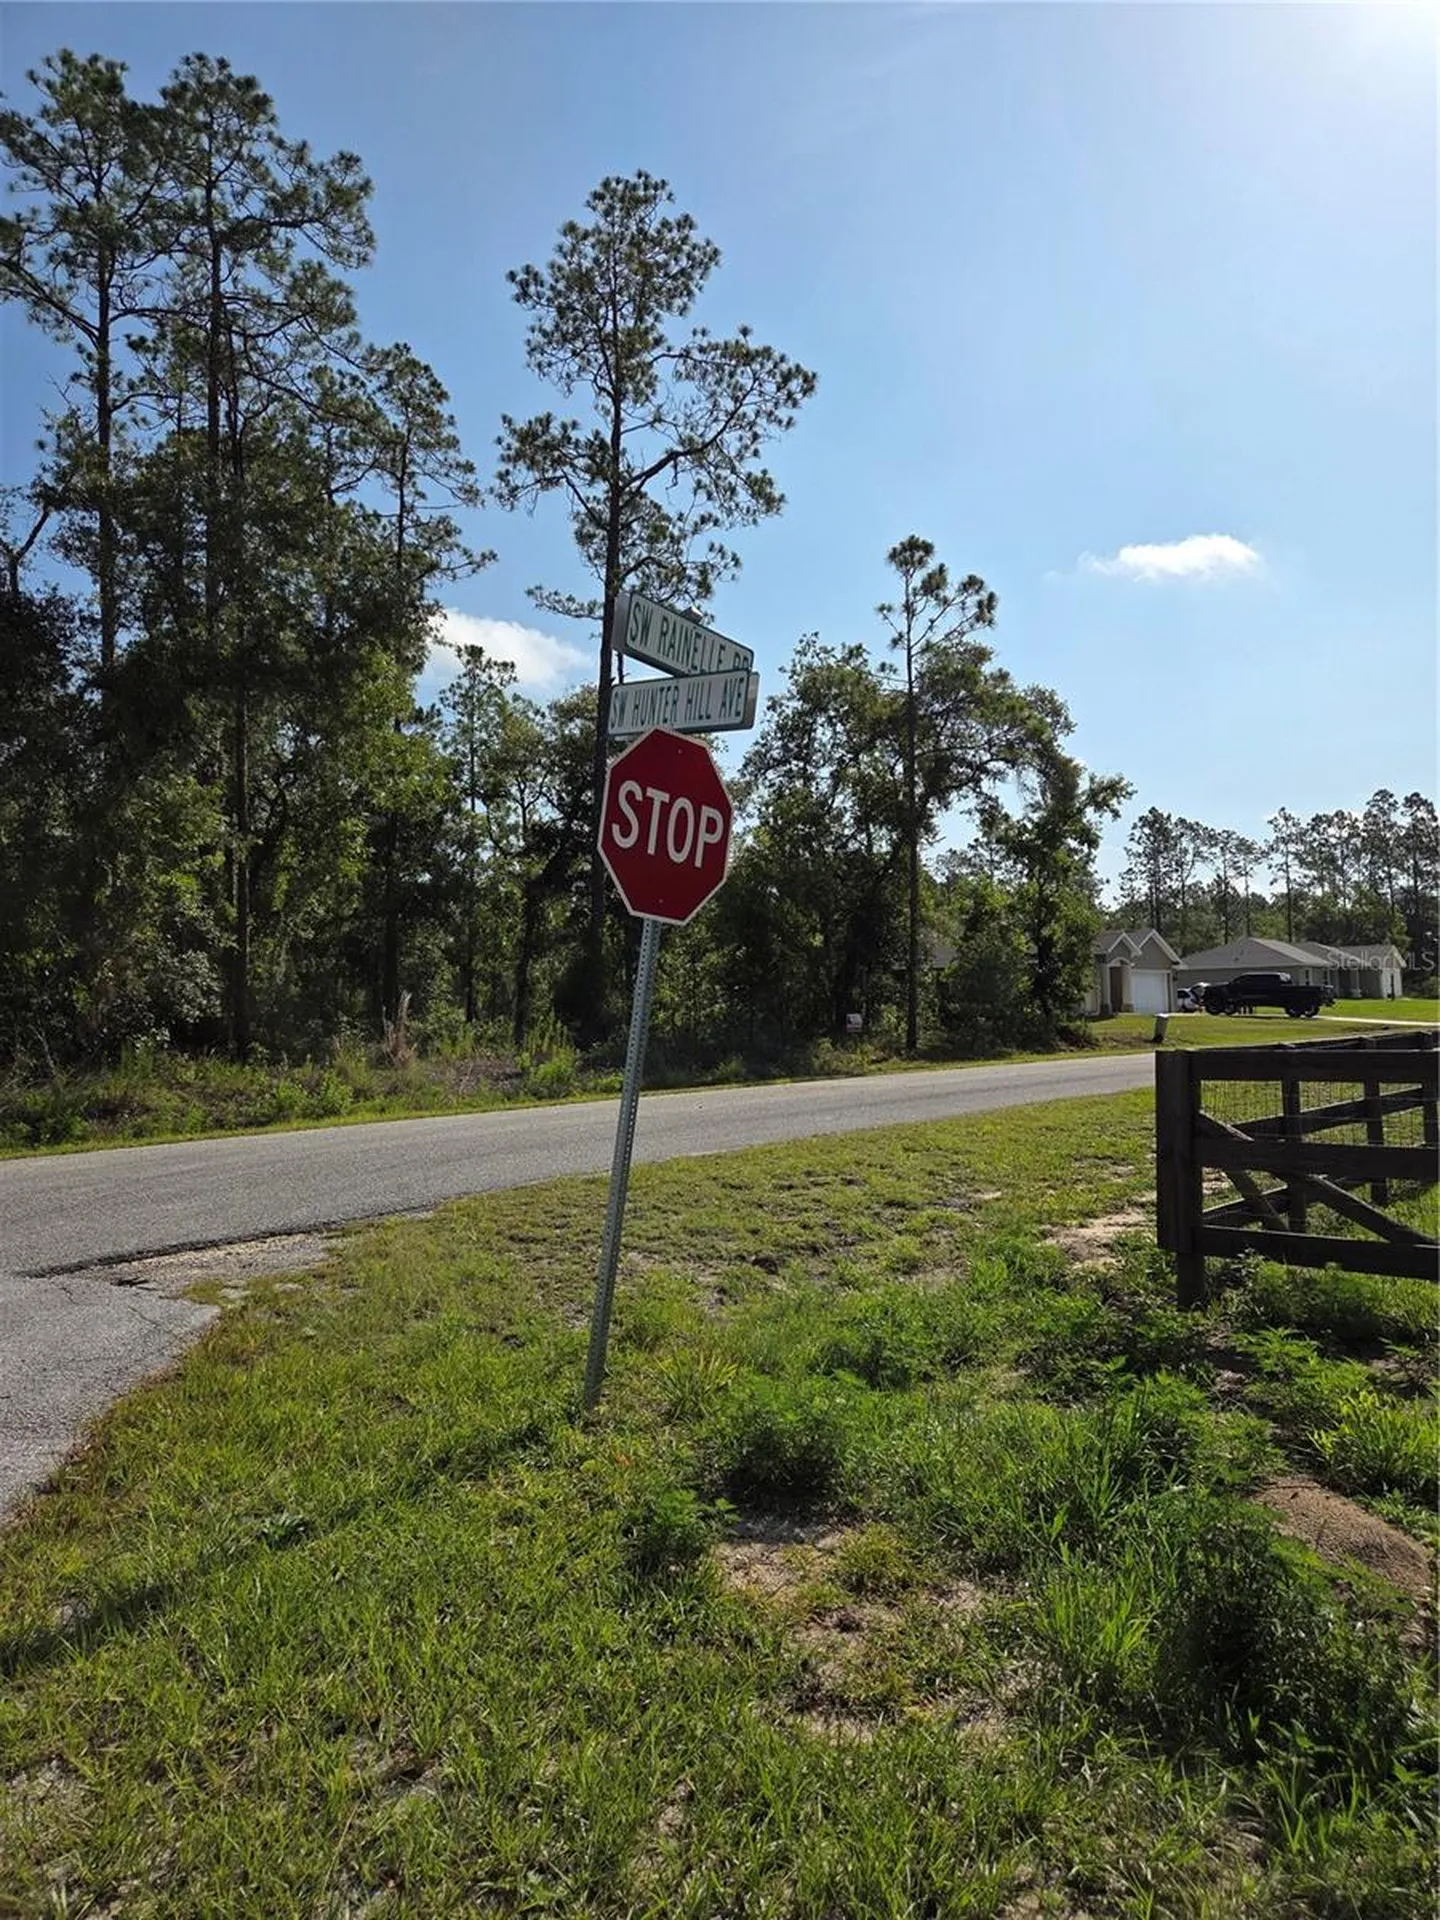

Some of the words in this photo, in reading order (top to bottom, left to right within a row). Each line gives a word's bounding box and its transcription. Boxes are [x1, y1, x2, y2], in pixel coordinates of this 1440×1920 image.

[630, 602, 653, 647] SW
[610, 691, 628, 729] SW
[631, 685, 679, 727] HUNTER
[684, 681, 711, 721] HILL
[719, 677, 744, 718] AVE
[612, 780, 724, 868] STOP
